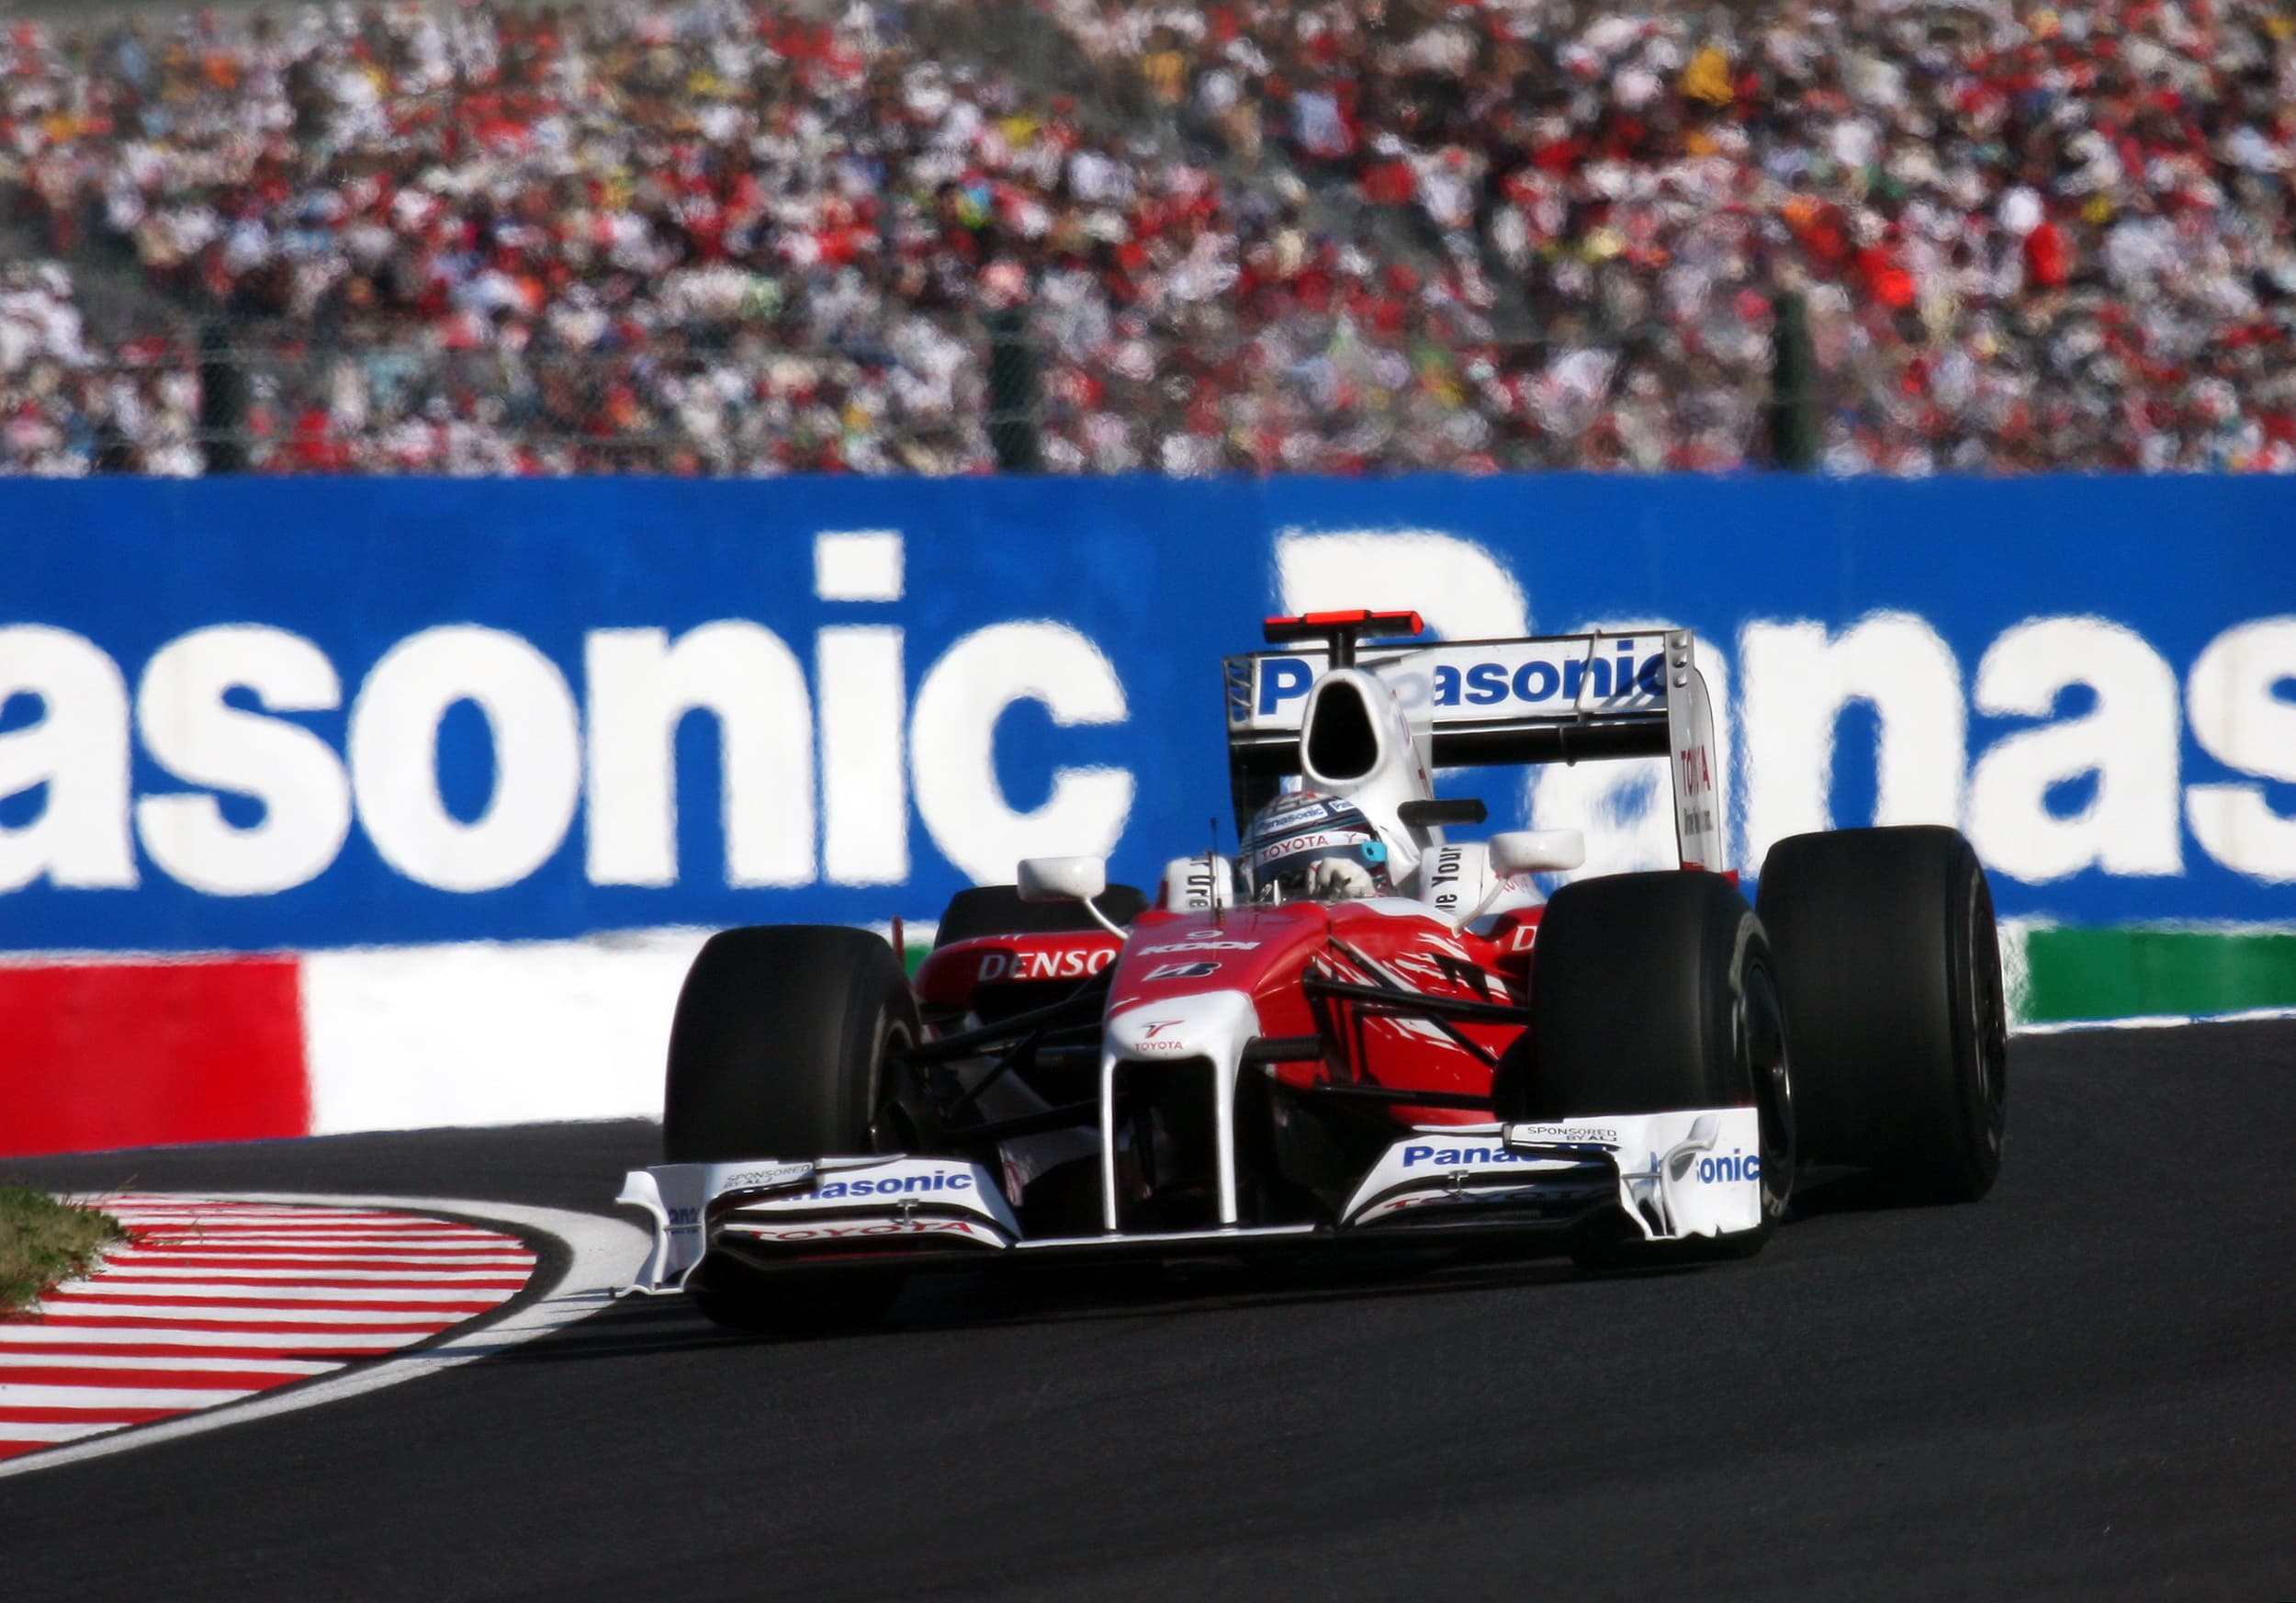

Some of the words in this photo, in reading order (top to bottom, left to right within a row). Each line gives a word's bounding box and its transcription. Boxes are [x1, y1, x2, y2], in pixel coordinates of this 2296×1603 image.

[1257, 638, 1668, 716] Pasonic
[1262, 834, 1329, 861] TOYOTA
[1431, 847, 1462, 888] Your
[977, 948, 1117, 982] DENSO
[1135, 1040, 1184, 1052] TOYOTA
[1527, 1126, 1617, 1136] SPONSORED
[726, 1164, 811, 1181] SPONSORED
[1695, 1147, 1760, 1184] onic
[751, 1221, 975, 1241] TOYOTA
